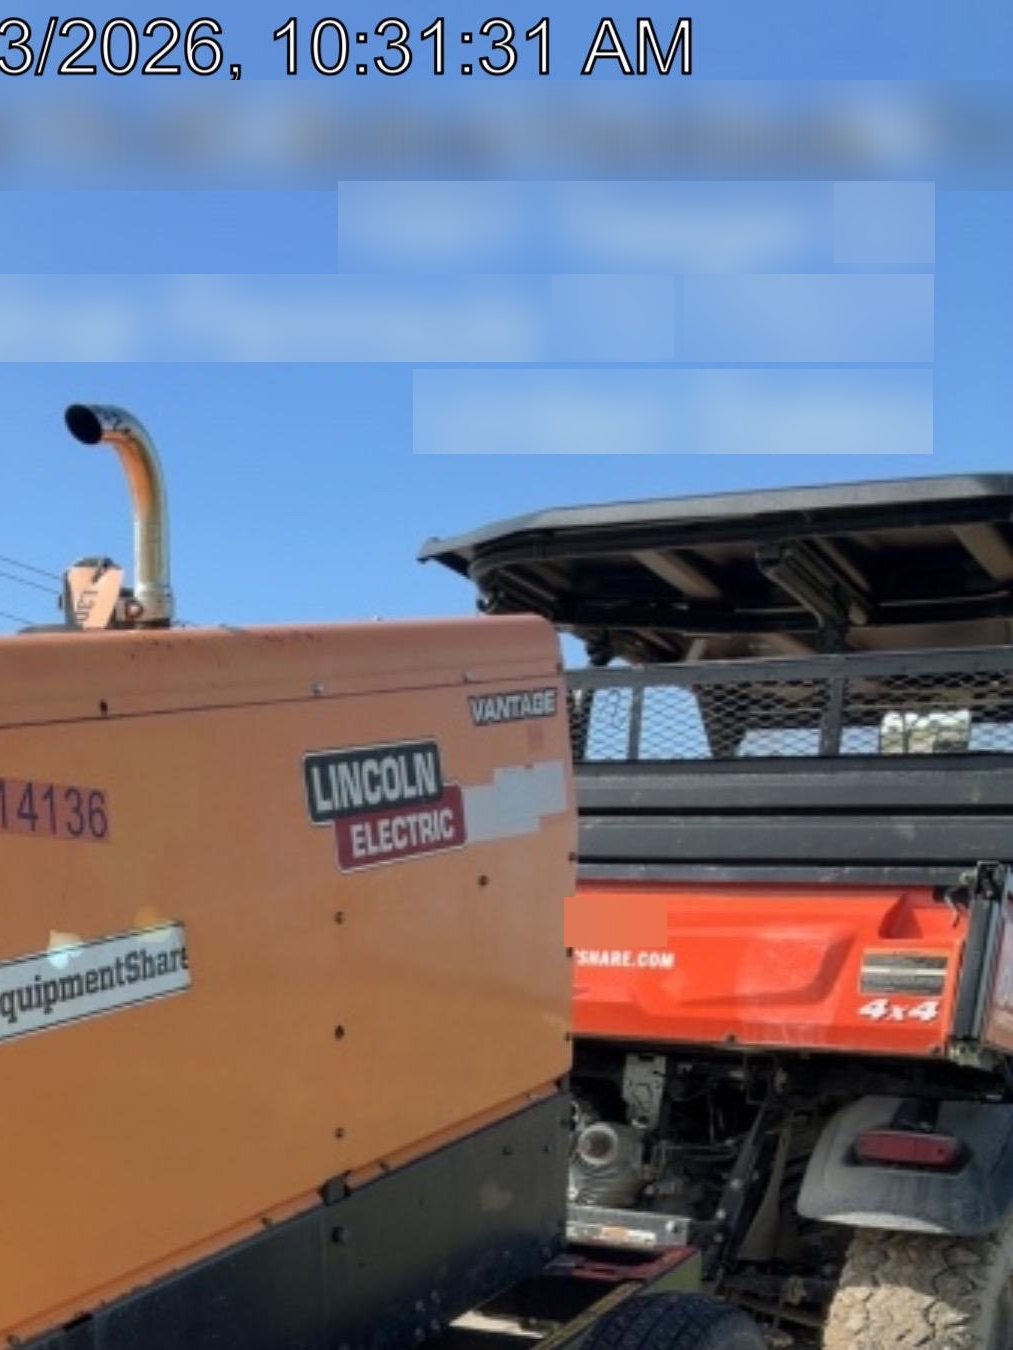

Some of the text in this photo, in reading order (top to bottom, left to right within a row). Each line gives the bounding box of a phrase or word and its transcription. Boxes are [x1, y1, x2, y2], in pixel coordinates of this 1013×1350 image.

[471, 689, 556, 724] VANTAGE
[310, 751, 438, 814] LINCOLN
[349, 807, 455, 859] ELECTRIC
[858, 998, 939, 1021] 4x4
